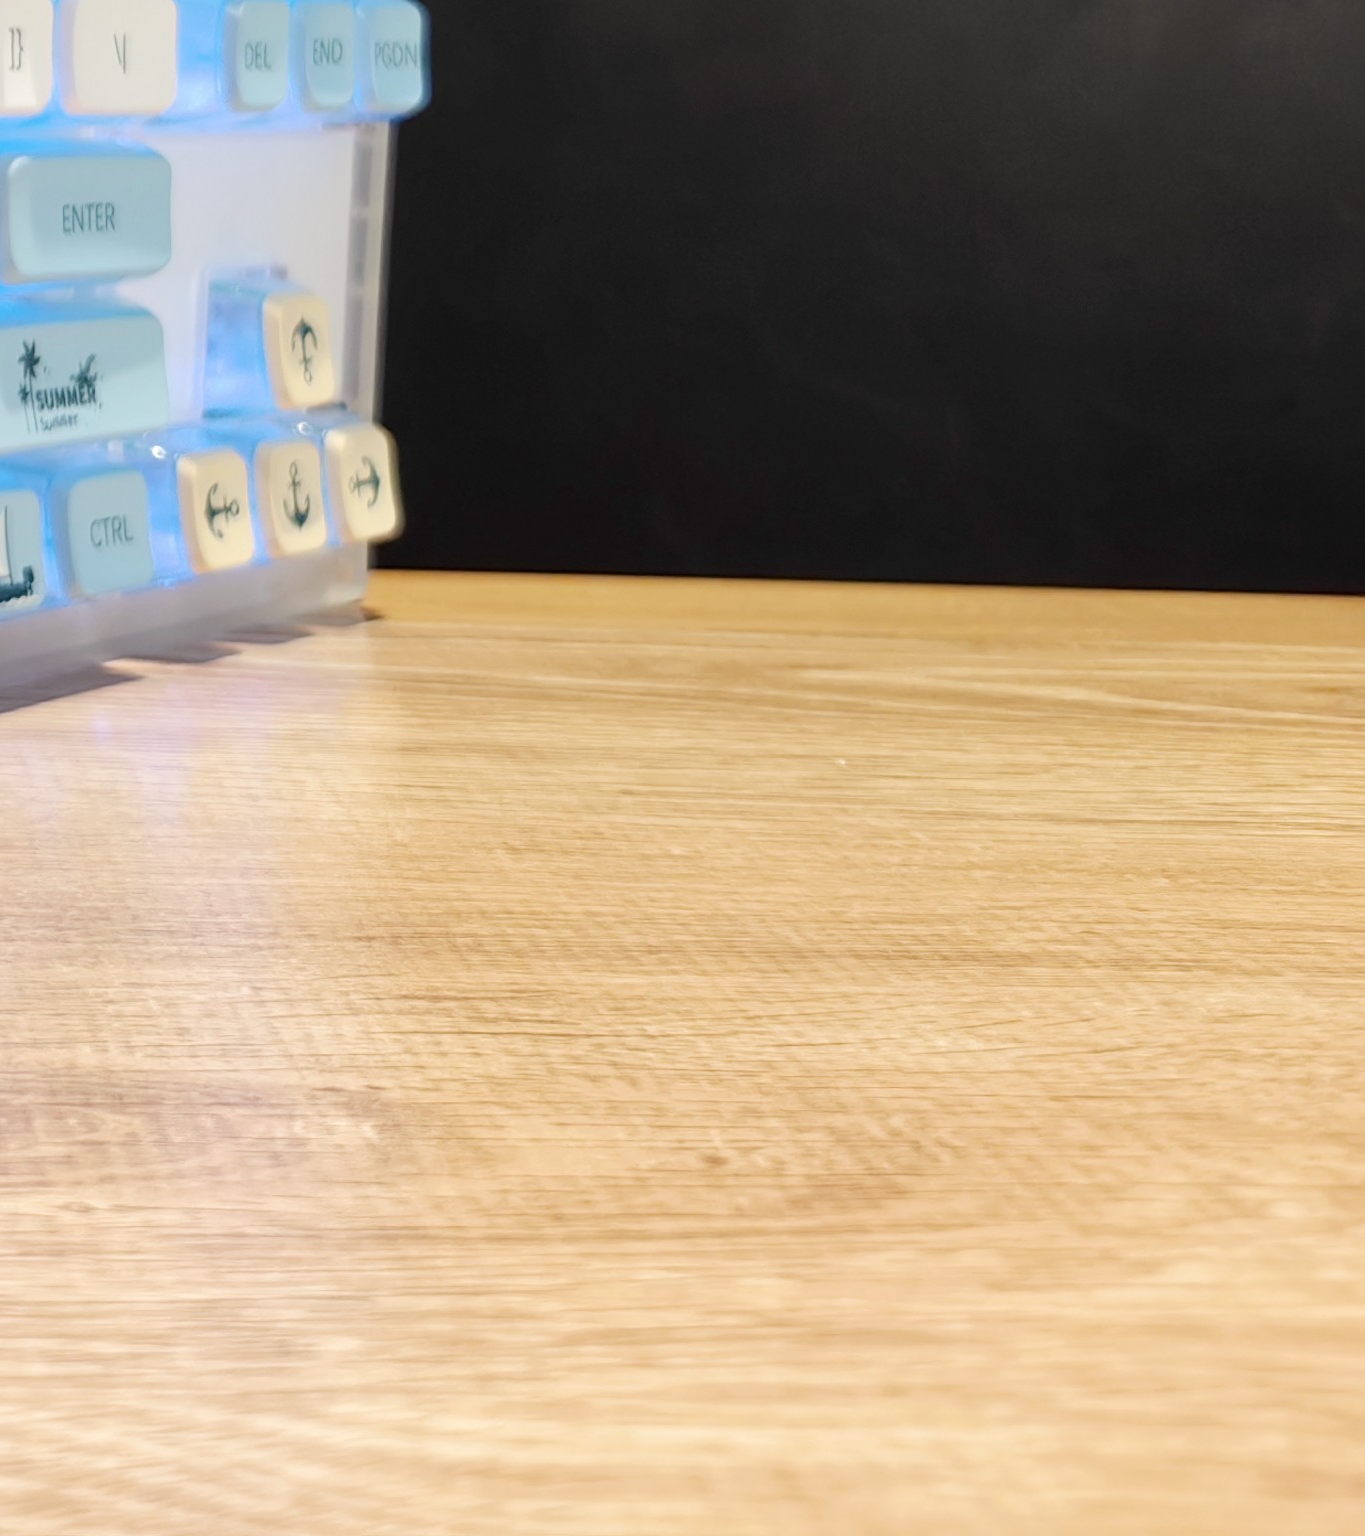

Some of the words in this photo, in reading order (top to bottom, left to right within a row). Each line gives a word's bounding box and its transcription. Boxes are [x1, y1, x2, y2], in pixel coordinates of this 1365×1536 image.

[244, 41, 272, 71] DEL
[312, 38, 344, 66] END
[374, 40, 419, 73] PGDN
[61, 201, 116, 235] ENTER
[35, 384, 98, 411] SUMMER
[90, 515, 134, 549] CTRL
